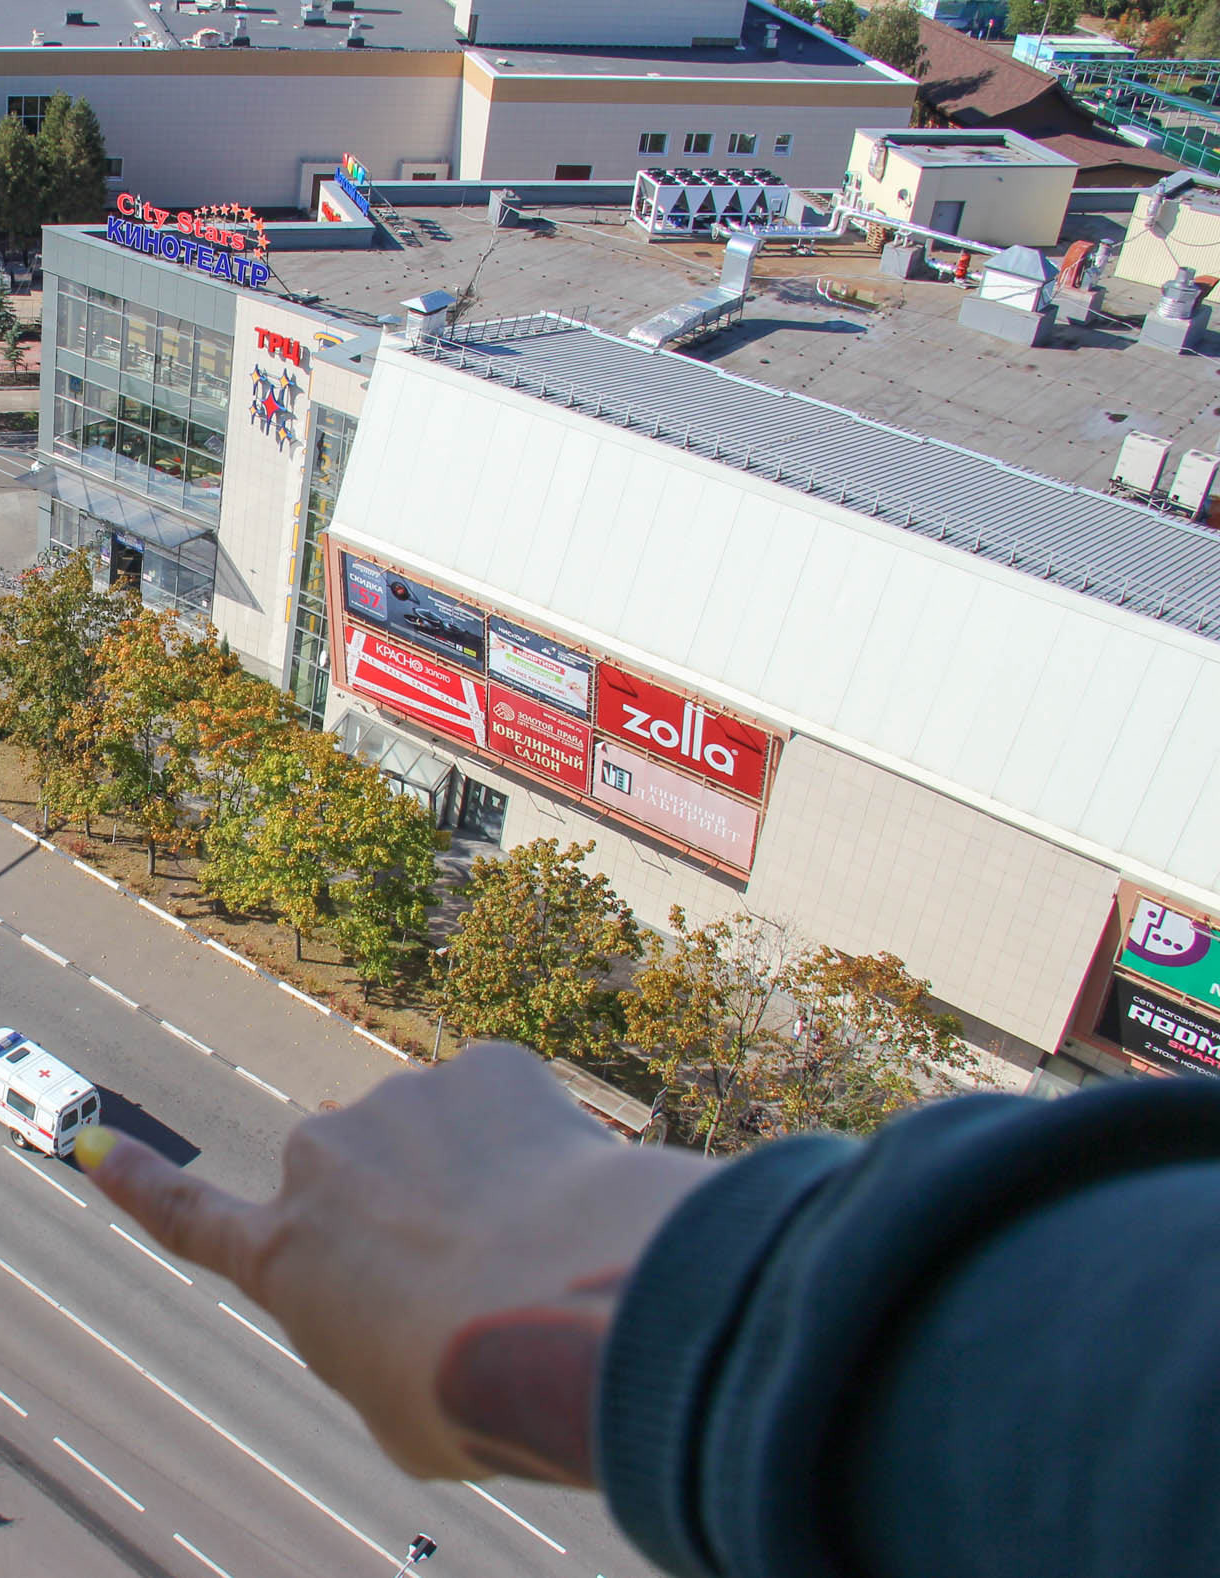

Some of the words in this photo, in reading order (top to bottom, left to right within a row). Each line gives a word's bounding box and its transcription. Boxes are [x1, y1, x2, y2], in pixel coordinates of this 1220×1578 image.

[117, 193, 169, 229] City
[177, 211, 245, 250] Stars
[106, 215, 270, 288] КИНОТЕАТР
[254, 327, 300, 367] ТРЦ
[350, 573, 383, 594] СКИДКА
[412, 679, 431, 694] SALE
[441, 694, 461, 709] SALE
[492, 721, 583, 771] ЮВЕЛИРНЫЙ
[518, 712, 553, 732] ЗОЛОТОЙ
[557, 729, 584, 748] ПРАЙД
[514, 745, 560, 773] САЛОН
[1133, 996, 1155, 1009] сеть
[1156, 1006, 1209, 1034] магазинов
